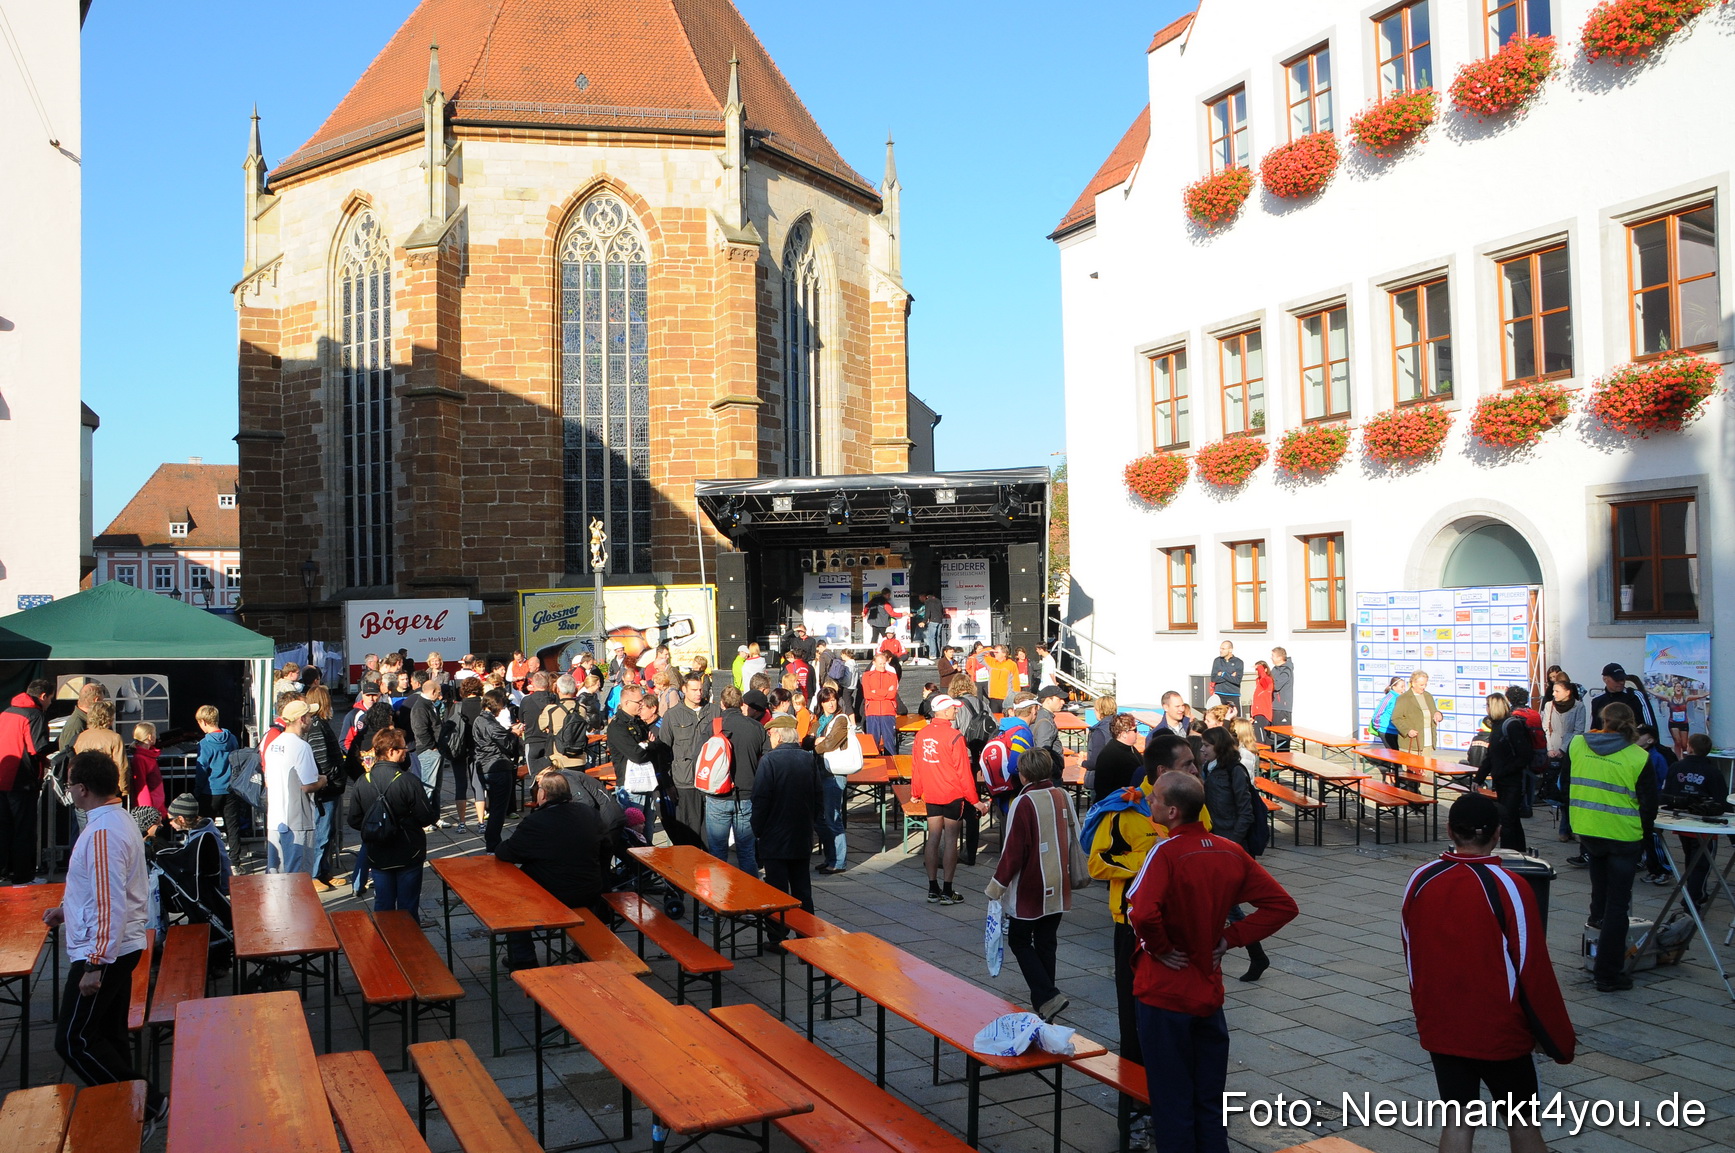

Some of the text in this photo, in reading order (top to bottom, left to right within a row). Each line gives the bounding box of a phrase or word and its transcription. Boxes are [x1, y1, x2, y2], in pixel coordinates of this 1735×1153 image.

[941, 562, 986, 571] FLEIDERER
[359, 609, 449, 639] Bögerl
[532, 605, 581, 632] Glossner
[557, 619, 581, 631] Bier
